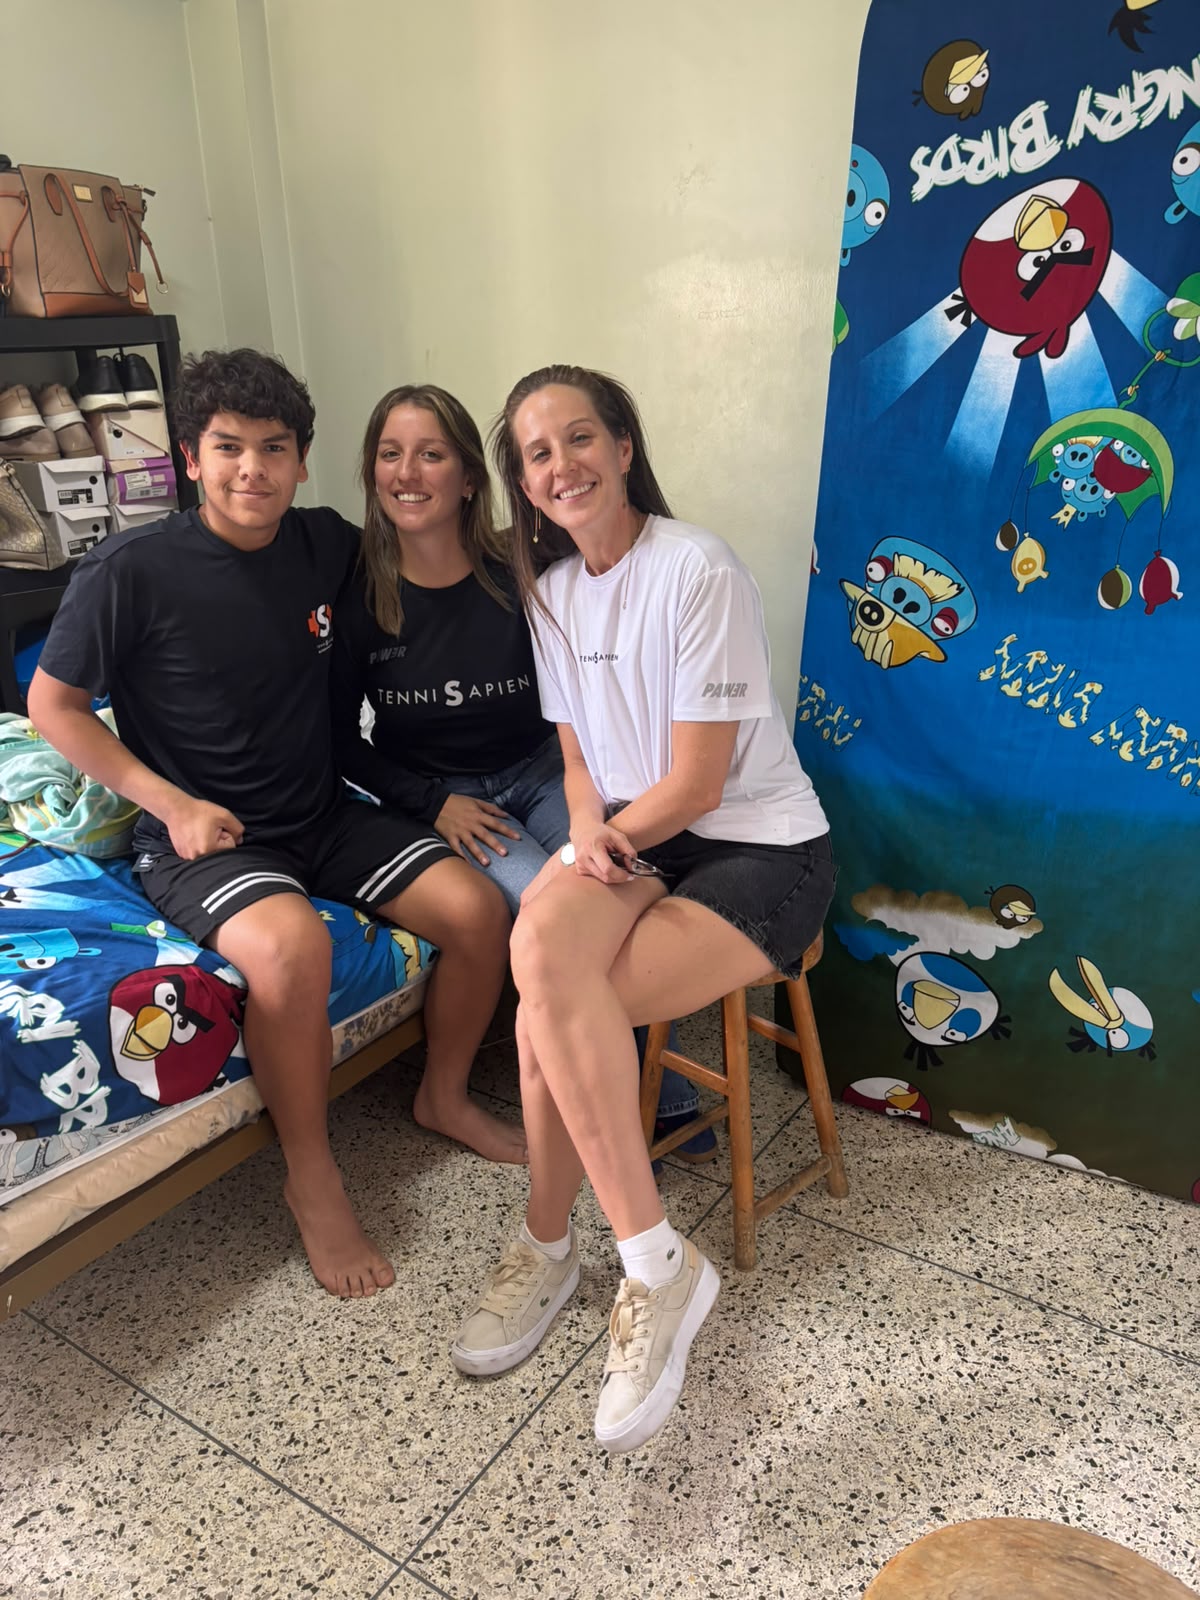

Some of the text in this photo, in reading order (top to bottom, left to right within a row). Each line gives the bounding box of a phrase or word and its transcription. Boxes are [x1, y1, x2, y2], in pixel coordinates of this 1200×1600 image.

[909, 53, 1200, 203] NGRY BIRDS
[1088, 703, 1200, 797] NGRY
